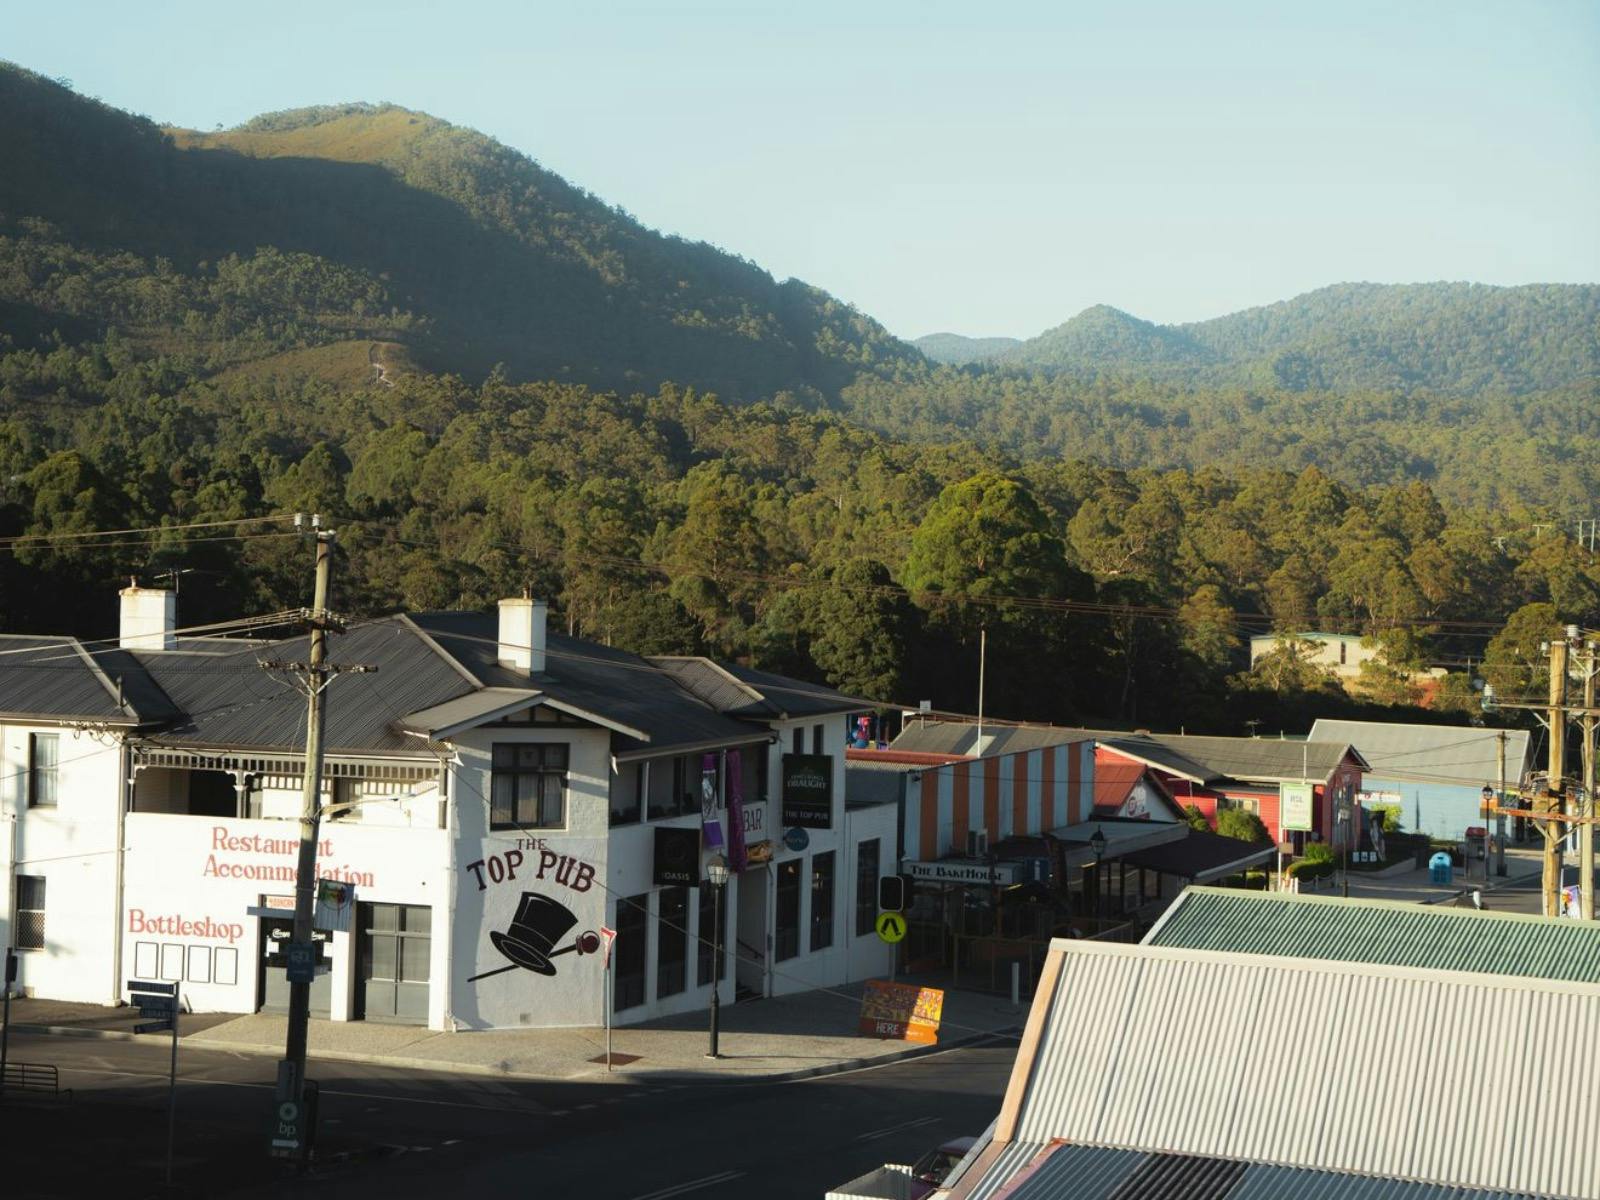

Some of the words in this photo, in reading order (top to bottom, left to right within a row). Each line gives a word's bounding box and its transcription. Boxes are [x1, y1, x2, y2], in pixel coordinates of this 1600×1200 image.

[743, 808, 762, 833] BAR
[516, 838, 546, 850] THE
[466, 850, 523, 891] TOP
[536, 850, 595, 892] PUB
[128, 908, 244, 944] Bottleshop
[280, 1121, 296, 1137] bp
